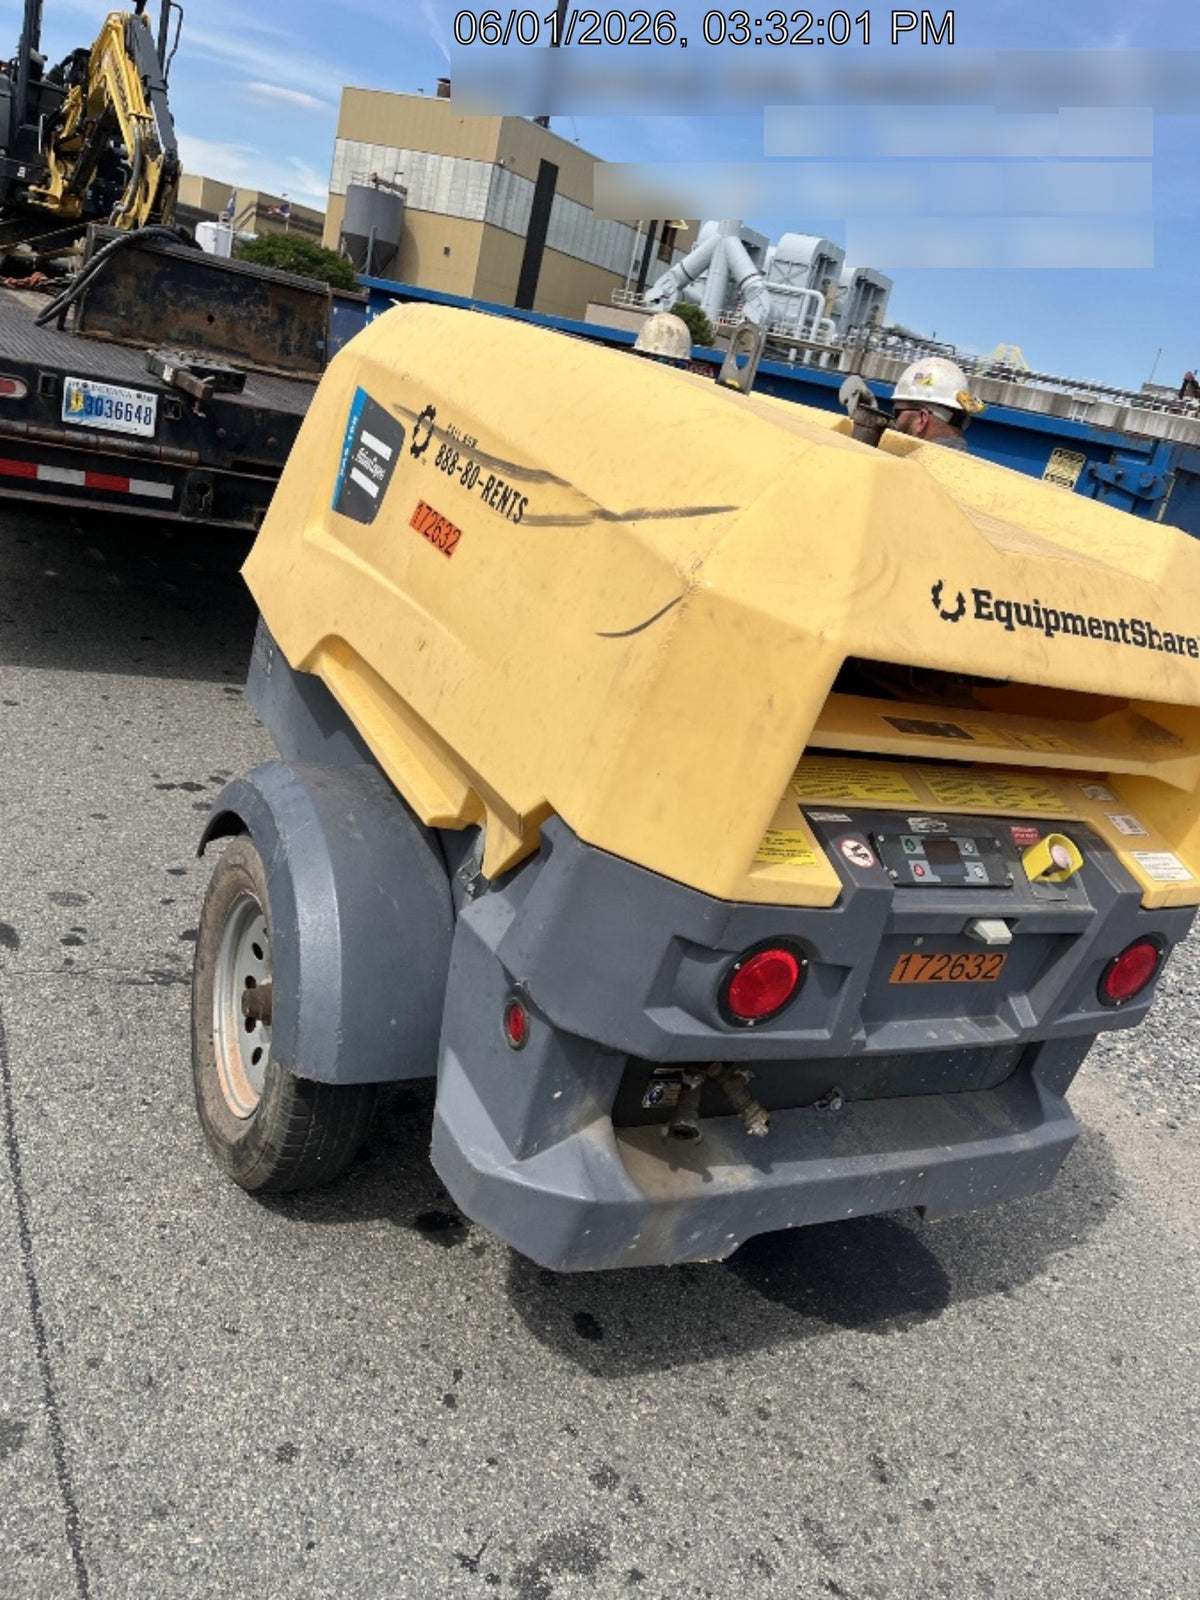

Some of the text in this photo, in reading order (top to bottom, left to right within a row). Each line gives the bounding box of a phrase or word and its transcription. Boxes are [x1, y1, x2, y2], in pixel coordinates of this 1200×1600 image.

[84, 395, 153, 425] 3036648
[434, 443, 529, 525] 888-80-RENTS
[412, 501, 463, 557] 172632
[971, 588, 1200, 658] EquipmentShare
[898, 953, 1004, 982] 172632
